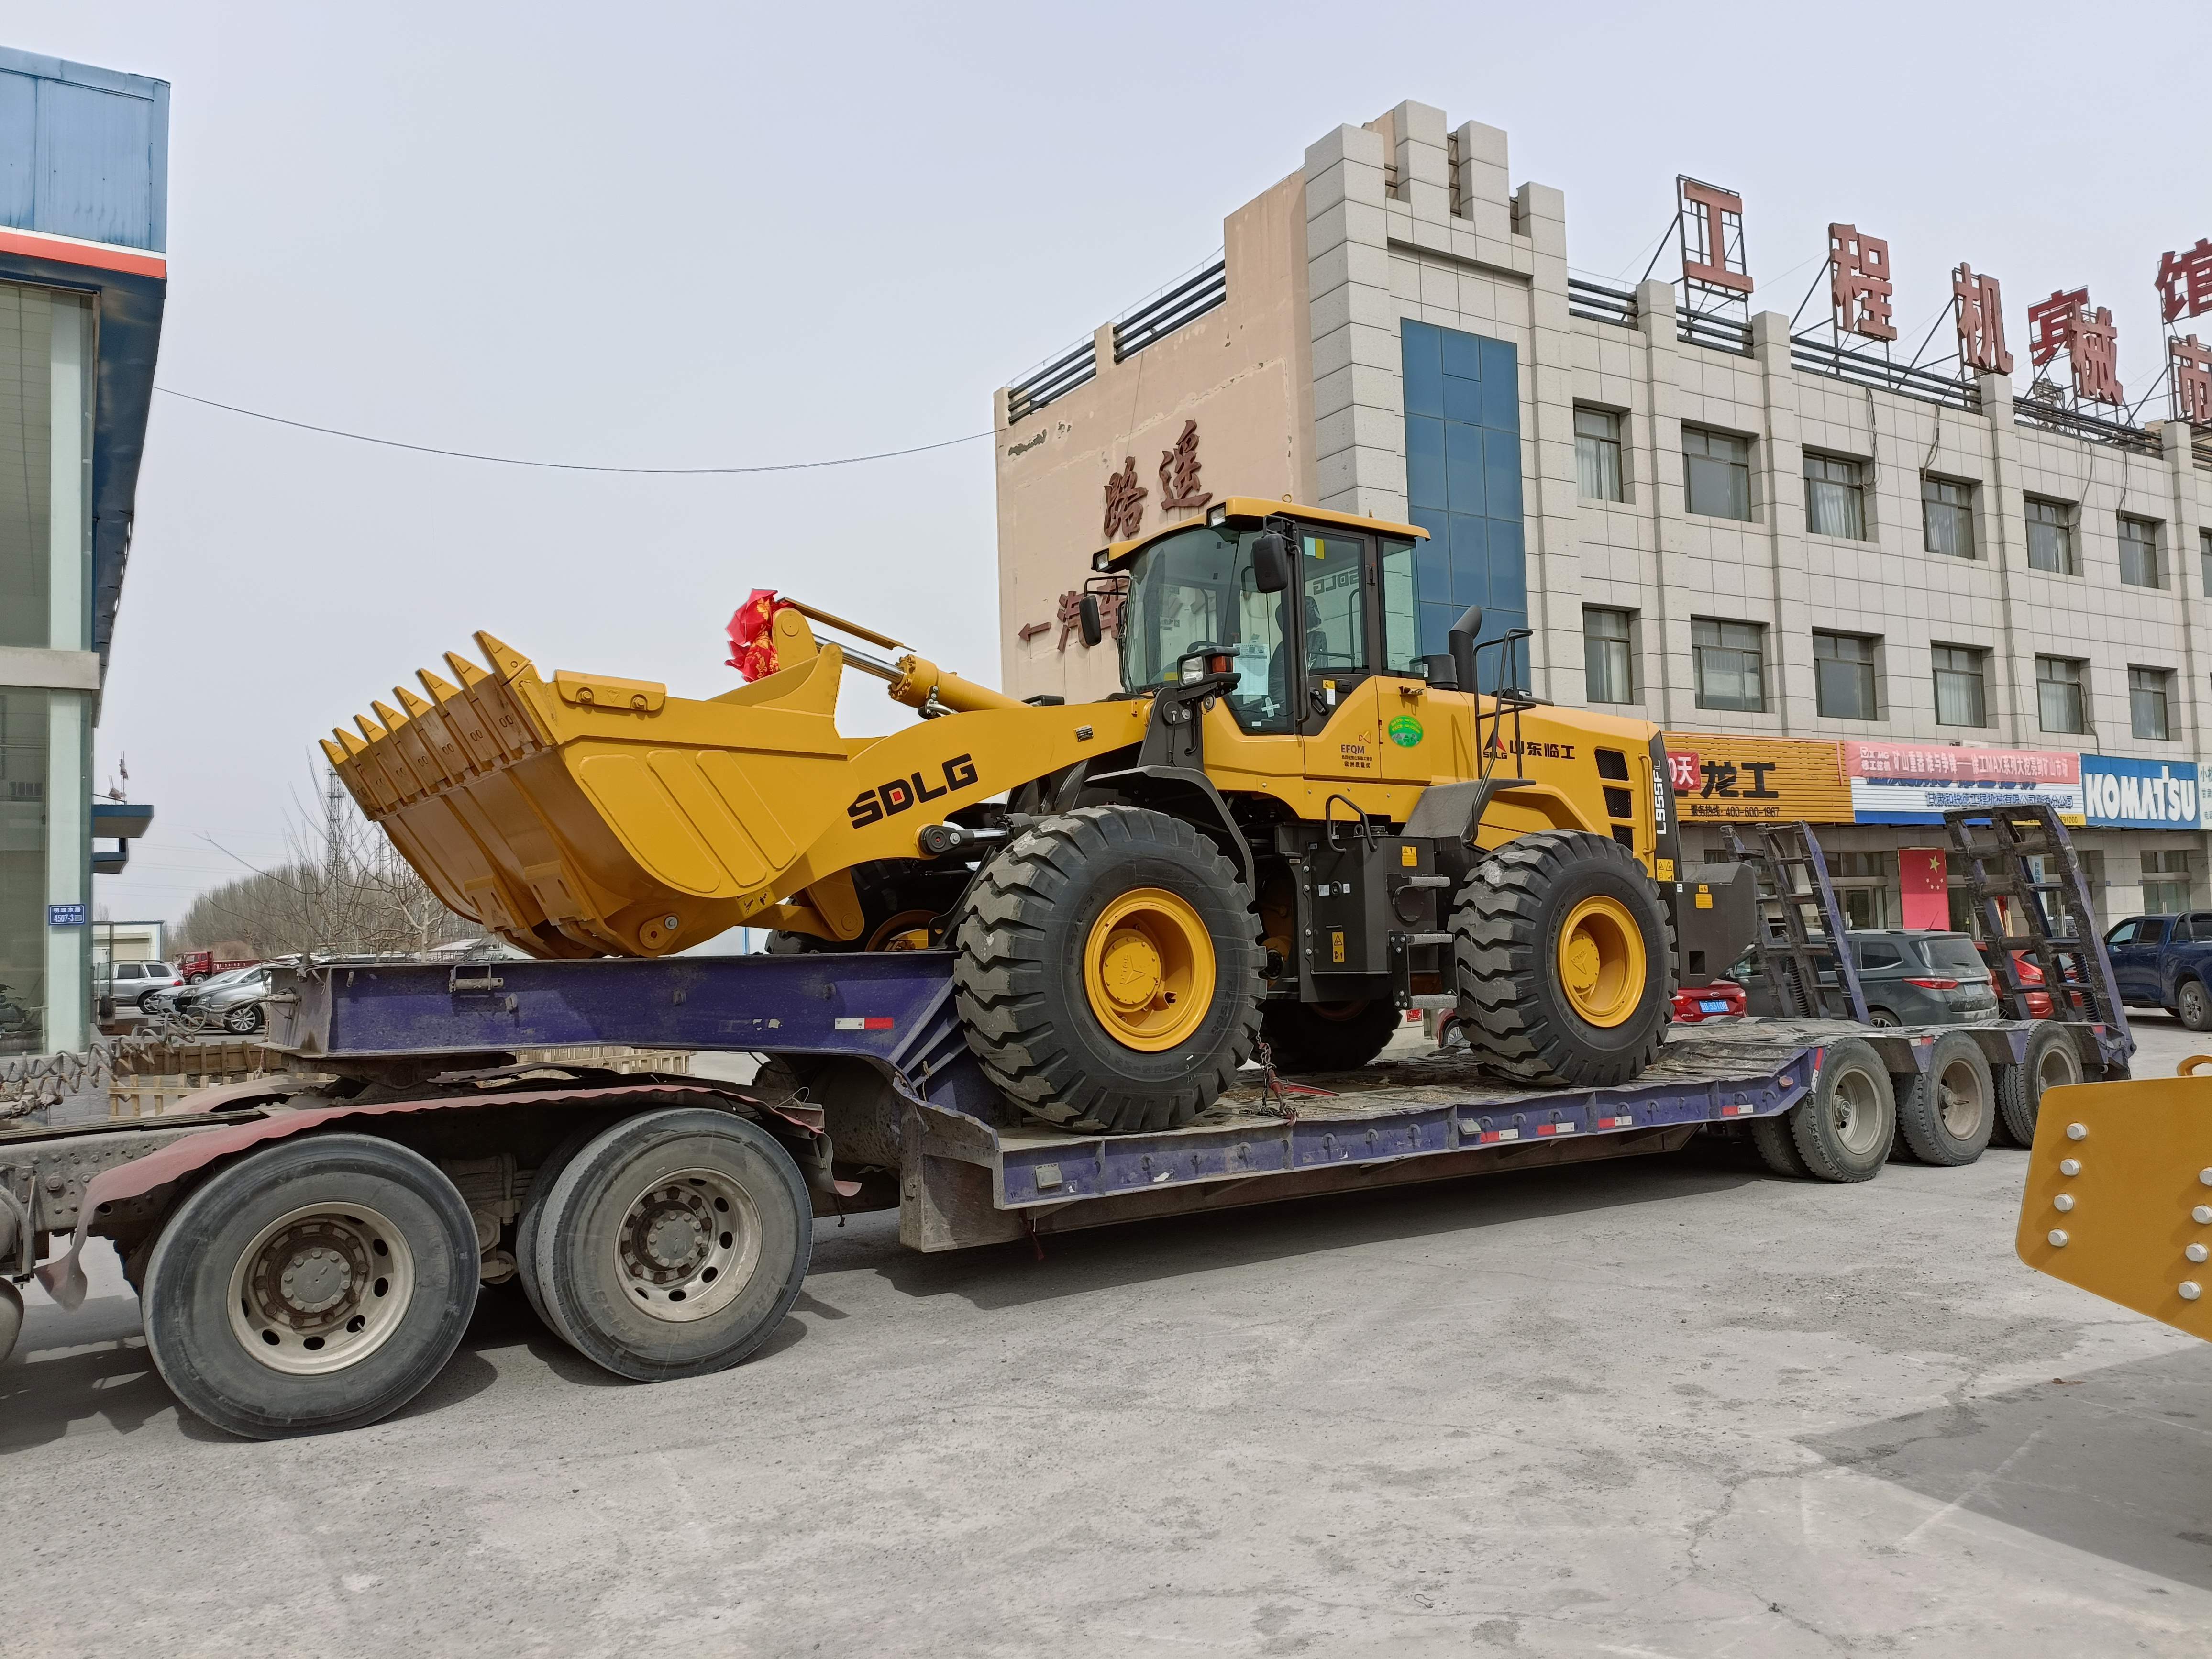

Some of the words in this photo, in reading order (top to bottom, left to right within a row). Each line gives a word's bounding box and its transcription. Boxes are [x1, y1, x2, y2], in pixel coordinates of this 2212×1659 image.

[1341, 744, 1364, 754] EFQM
[1509, 740, 1575, 760] 山东临工
[846, 753, 979, 830] SDLG
[2085, 765, 2196, 822] KOMATSU
[54, 914, 74, 922] 4507-3
